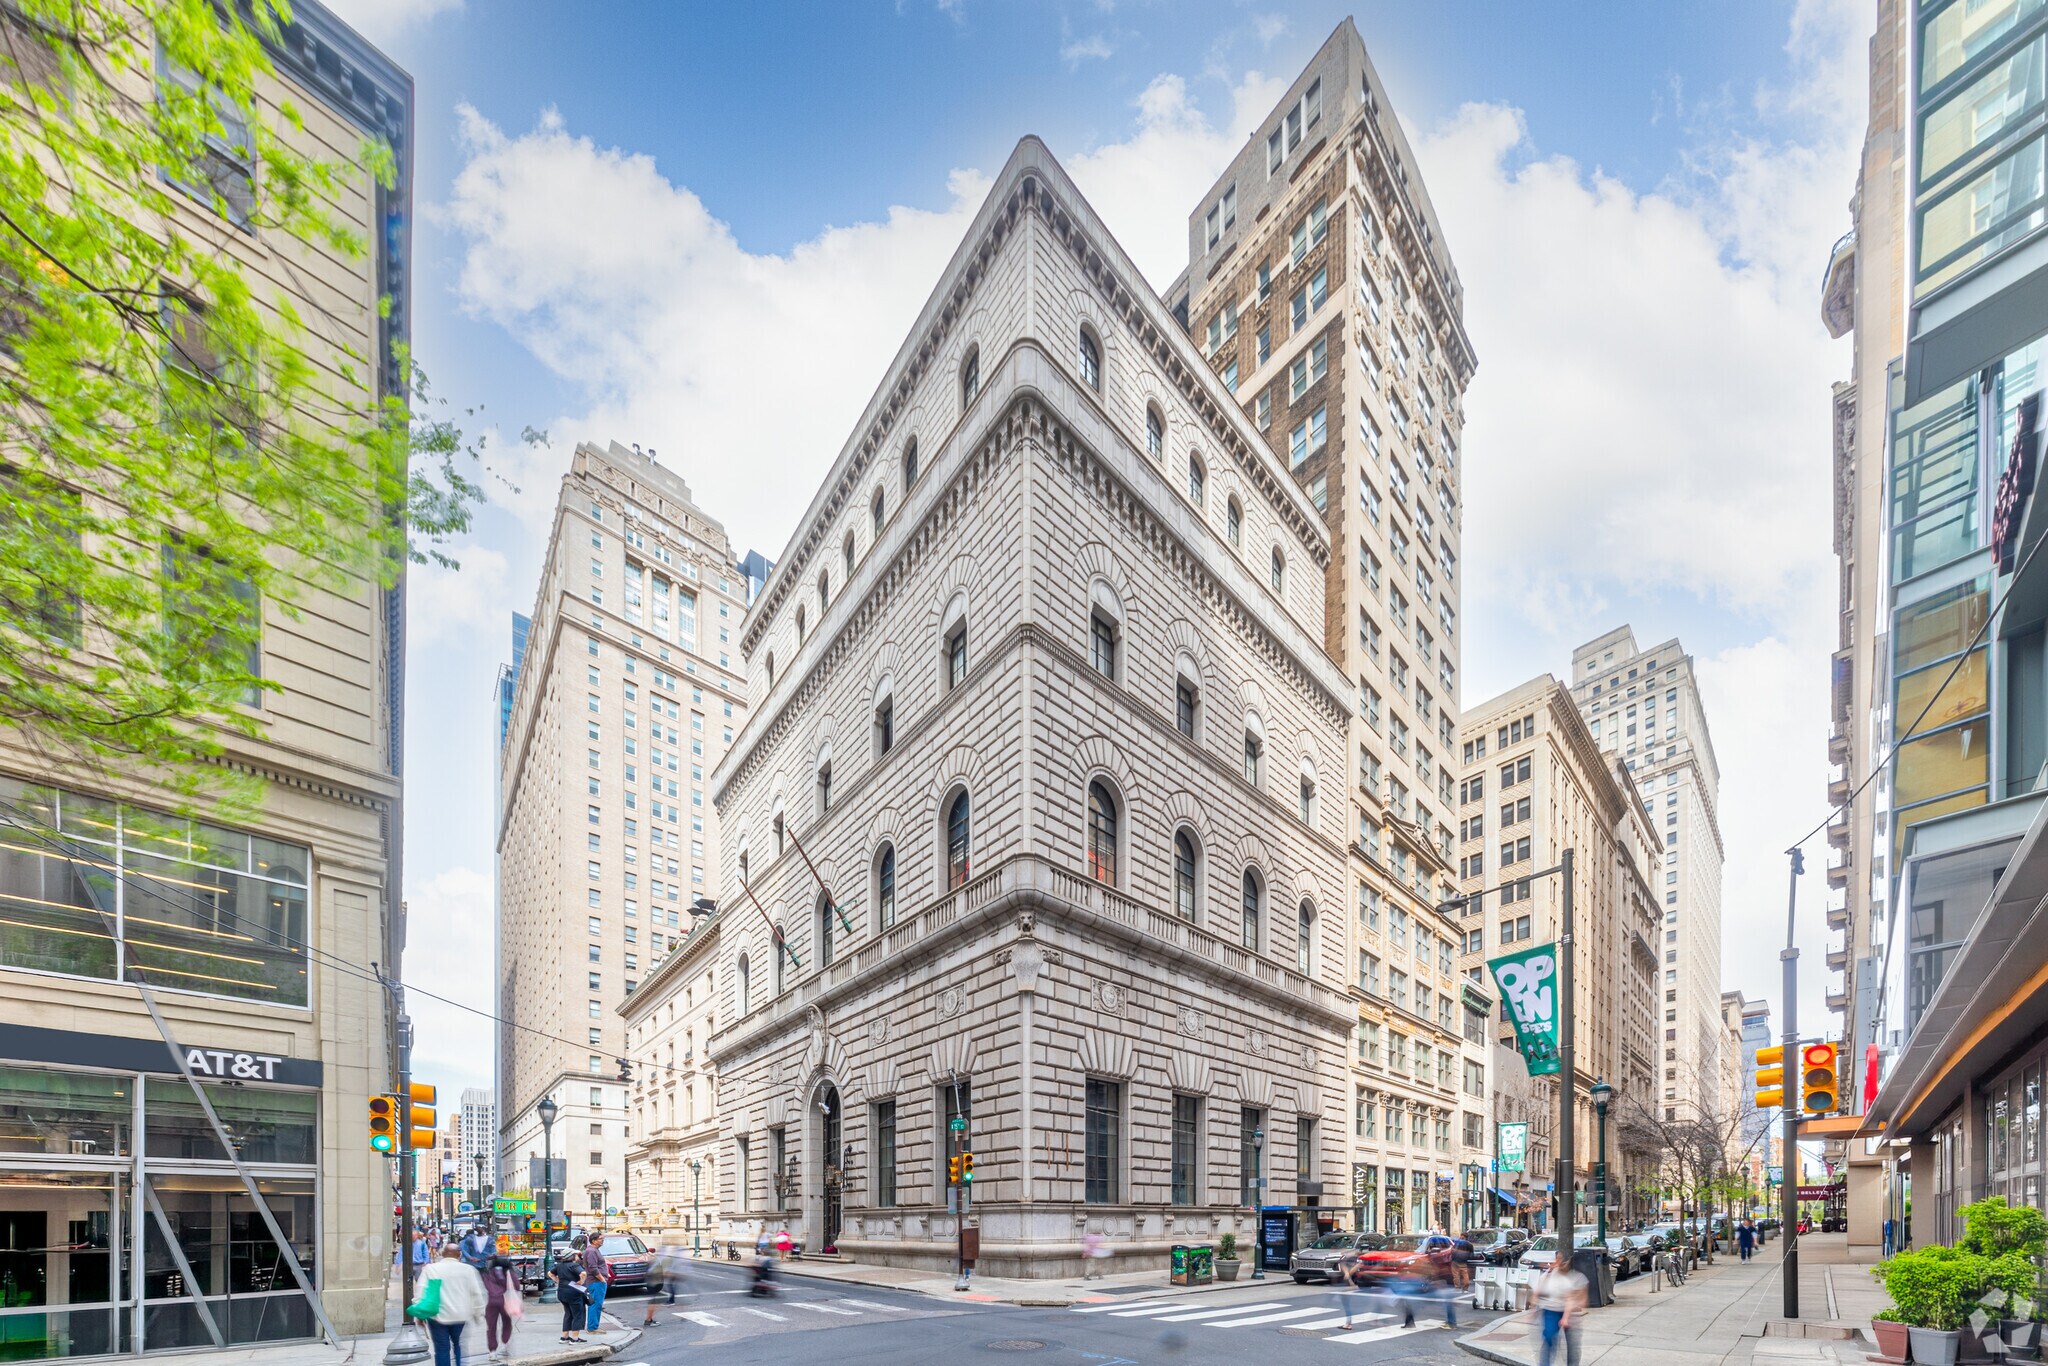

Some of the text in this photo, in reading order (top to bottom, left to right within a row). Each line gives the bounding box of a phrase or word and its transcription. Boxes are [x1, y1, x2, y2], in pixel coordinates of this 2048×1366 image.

[1495, 955, 1554, 994] OP
[186, 1049, 282, 1080] AT&T
[1502, 1126, 1525, 1141] OP
[1502, 1137, 1523, 1150] EN
[1353, 1166, 1367, 1204] xfinity
